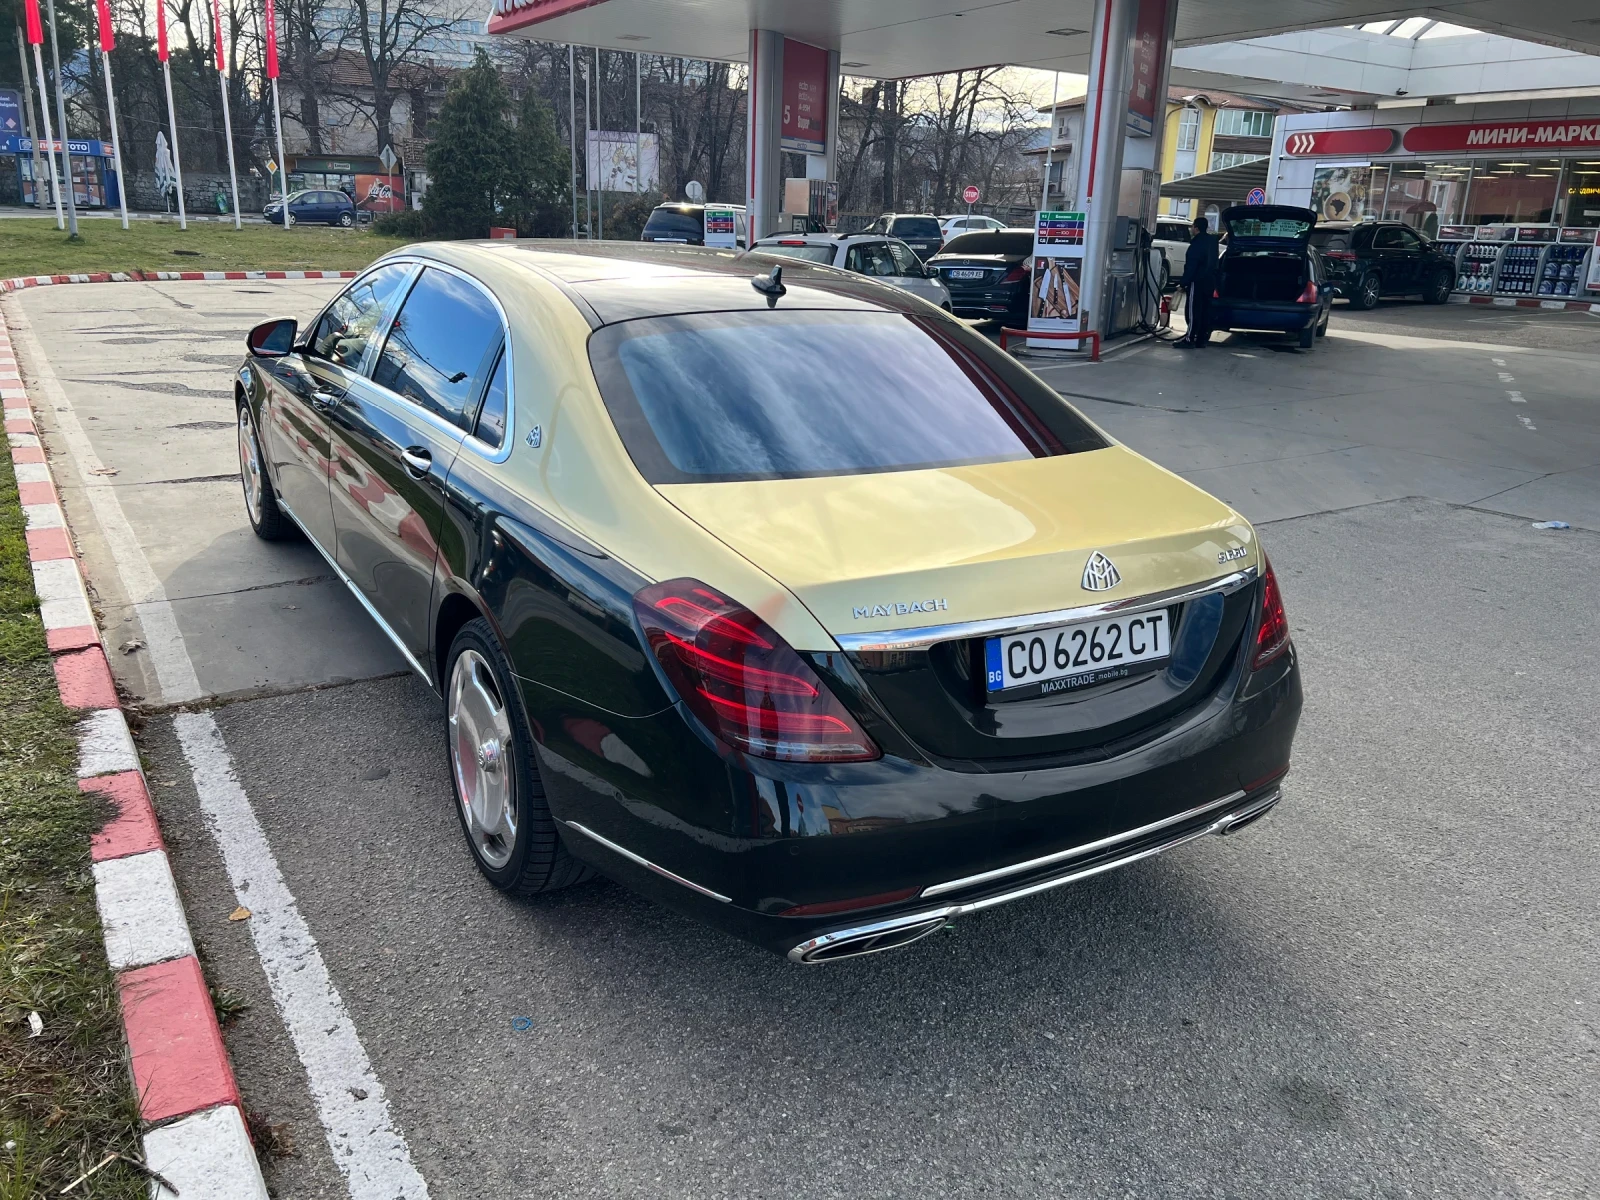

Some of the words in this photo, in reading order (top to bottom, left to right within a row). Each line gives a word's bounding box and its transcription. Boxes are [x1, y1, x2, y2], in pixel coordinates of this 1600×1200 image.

[783, 105, 791, 124] 5
[853, 598, 948, 619] MAYBACH
[988, 670, 1002, 683] BG
[1007, 637, 1047, 679] CO
[1053, 623, 1123, 670] 6262
[1128, 615, 1163, 656] CT
